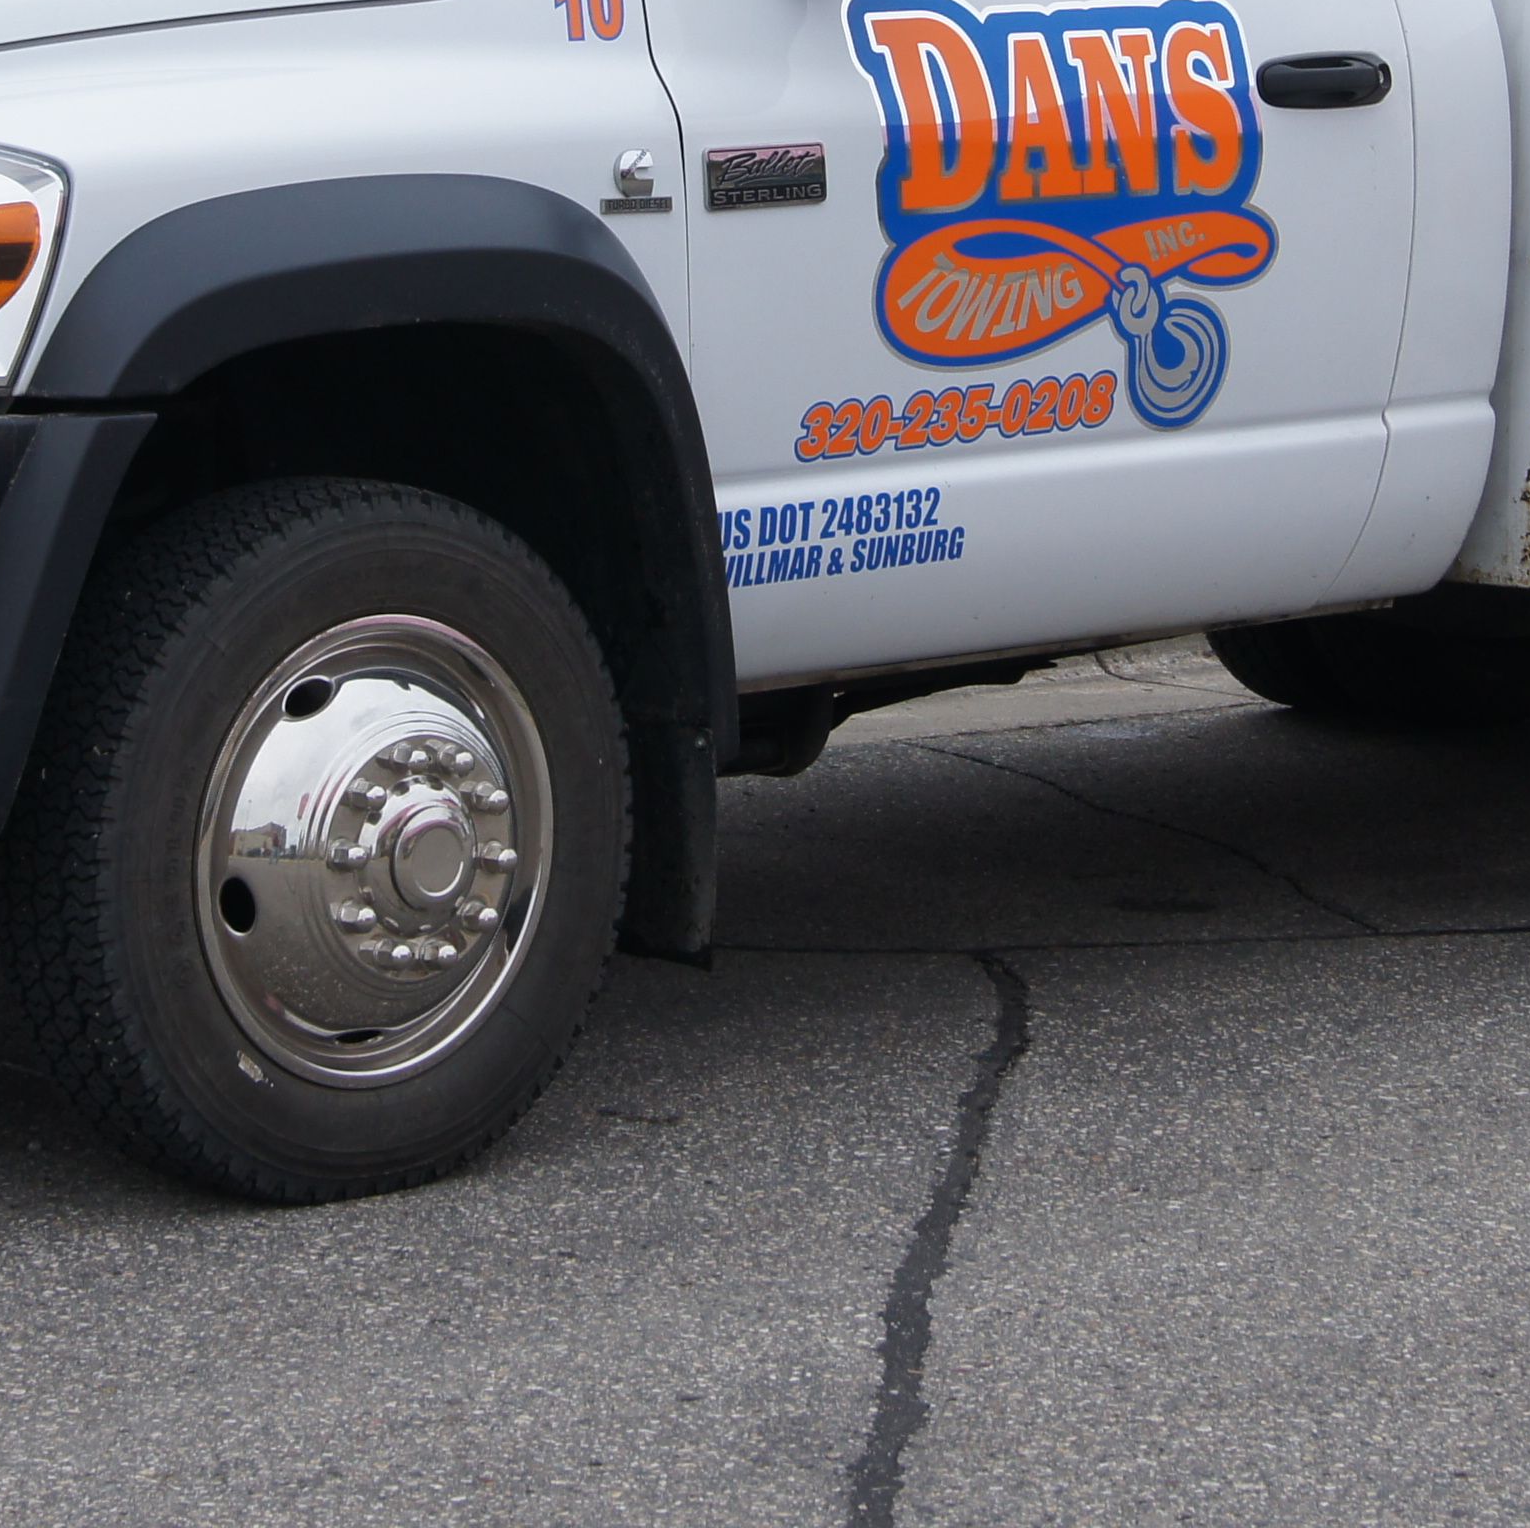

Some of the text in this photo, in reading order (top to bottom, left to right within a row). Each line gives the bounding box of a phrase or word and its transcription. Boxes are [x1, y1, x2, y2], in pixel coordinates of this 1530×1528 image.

[864, 11, 1243, 215] DANS
[713, 184, 822, 205] STERLING
[719, 151, 815, 185] Bullet
[1144, 221, 1206, 261] INC.
[897, 252, 1084, 340] TOWING
[796, 370, 1117, 462] 320-235-0208
[717, 487, 941, 552] US DOT 2483132
[827, 547, 844, 576] &
[850, 526, 965, 574] SUNBURG
